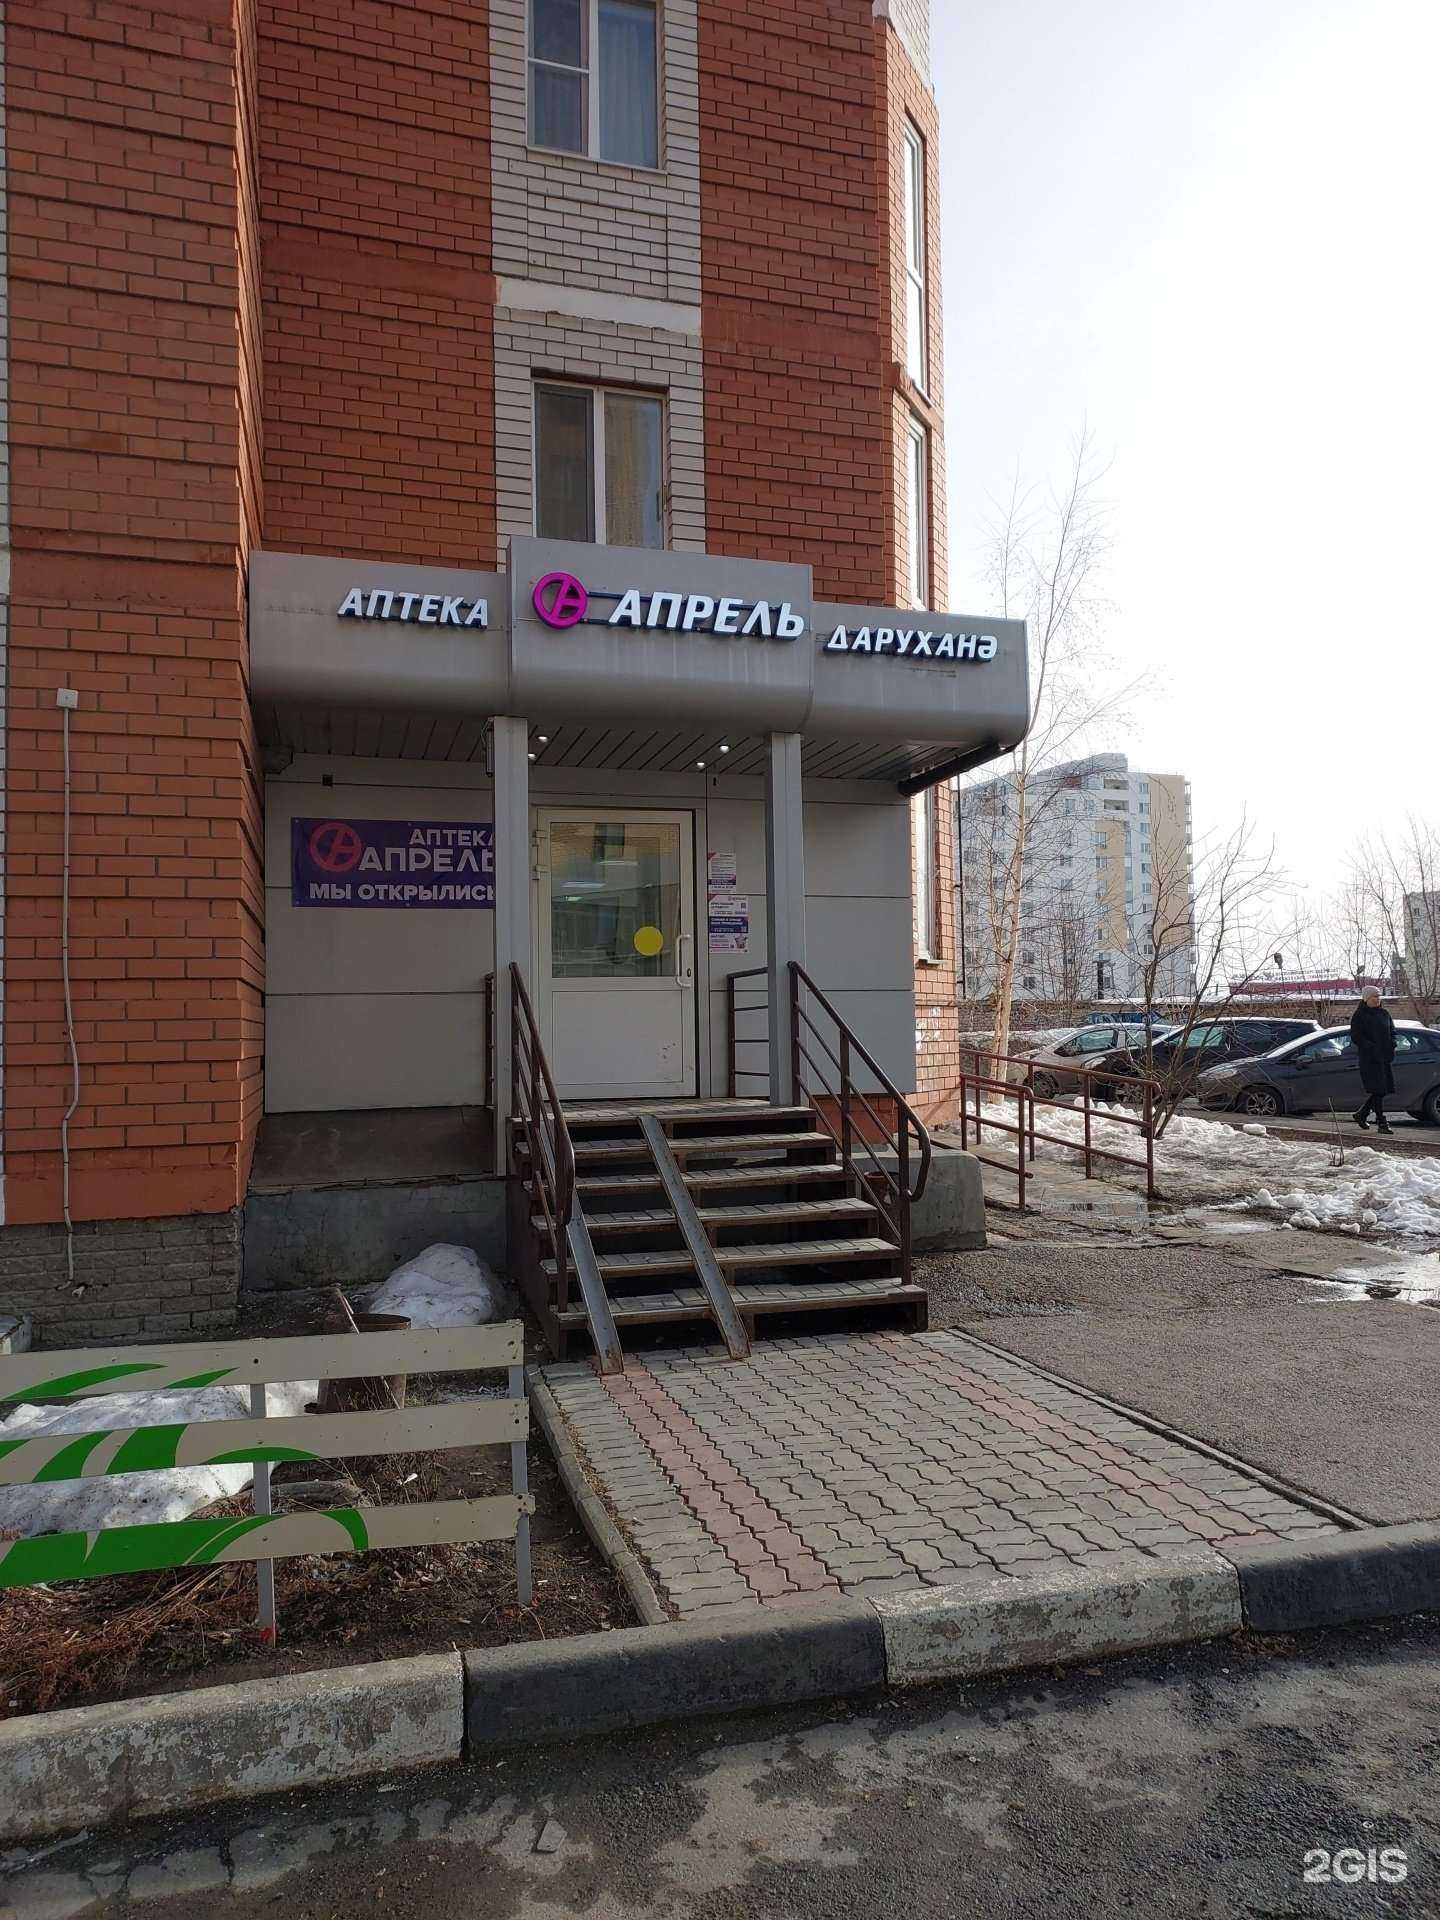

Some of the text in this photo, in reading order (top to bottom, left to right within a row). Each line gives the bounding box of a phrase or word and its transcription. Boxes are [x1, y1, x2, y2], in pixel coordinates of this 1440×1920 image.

[337, 588, 489, 627] АПТЕКА
[608, 590, 805, 638] АПРЕЛЬ
[309, 883, 351, 900] МЫ
